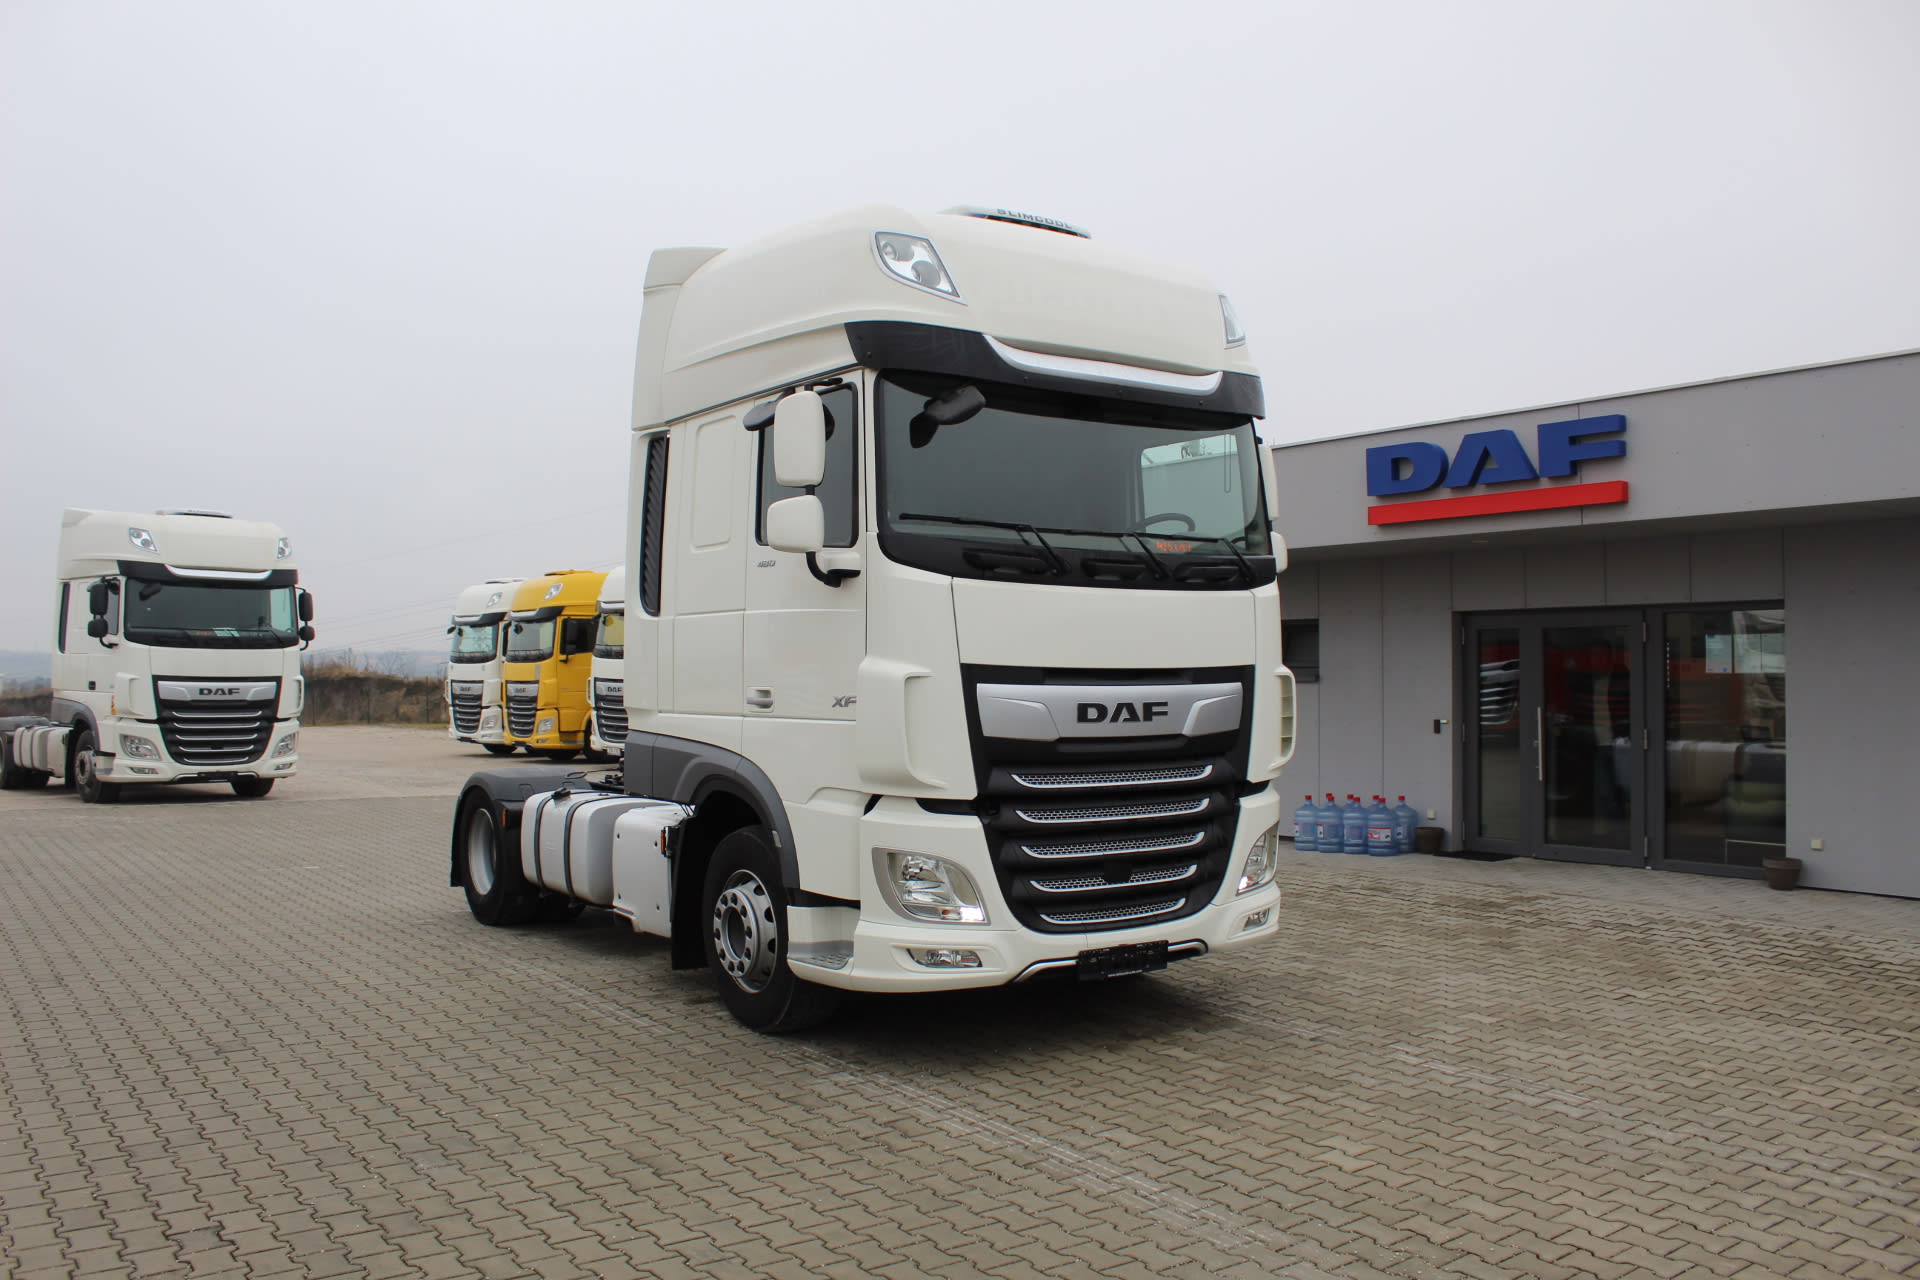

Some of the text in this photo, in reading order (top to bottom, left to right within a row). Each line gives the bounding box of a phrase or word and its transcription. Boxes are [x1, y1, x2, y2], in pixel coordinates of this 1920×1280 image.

[1366, 414, 1626, 496] DAF
[199, 688, 241, 696] DAF
[832, 696, 857, 708] XF
[1077, 702, 1168, 723] DAF
